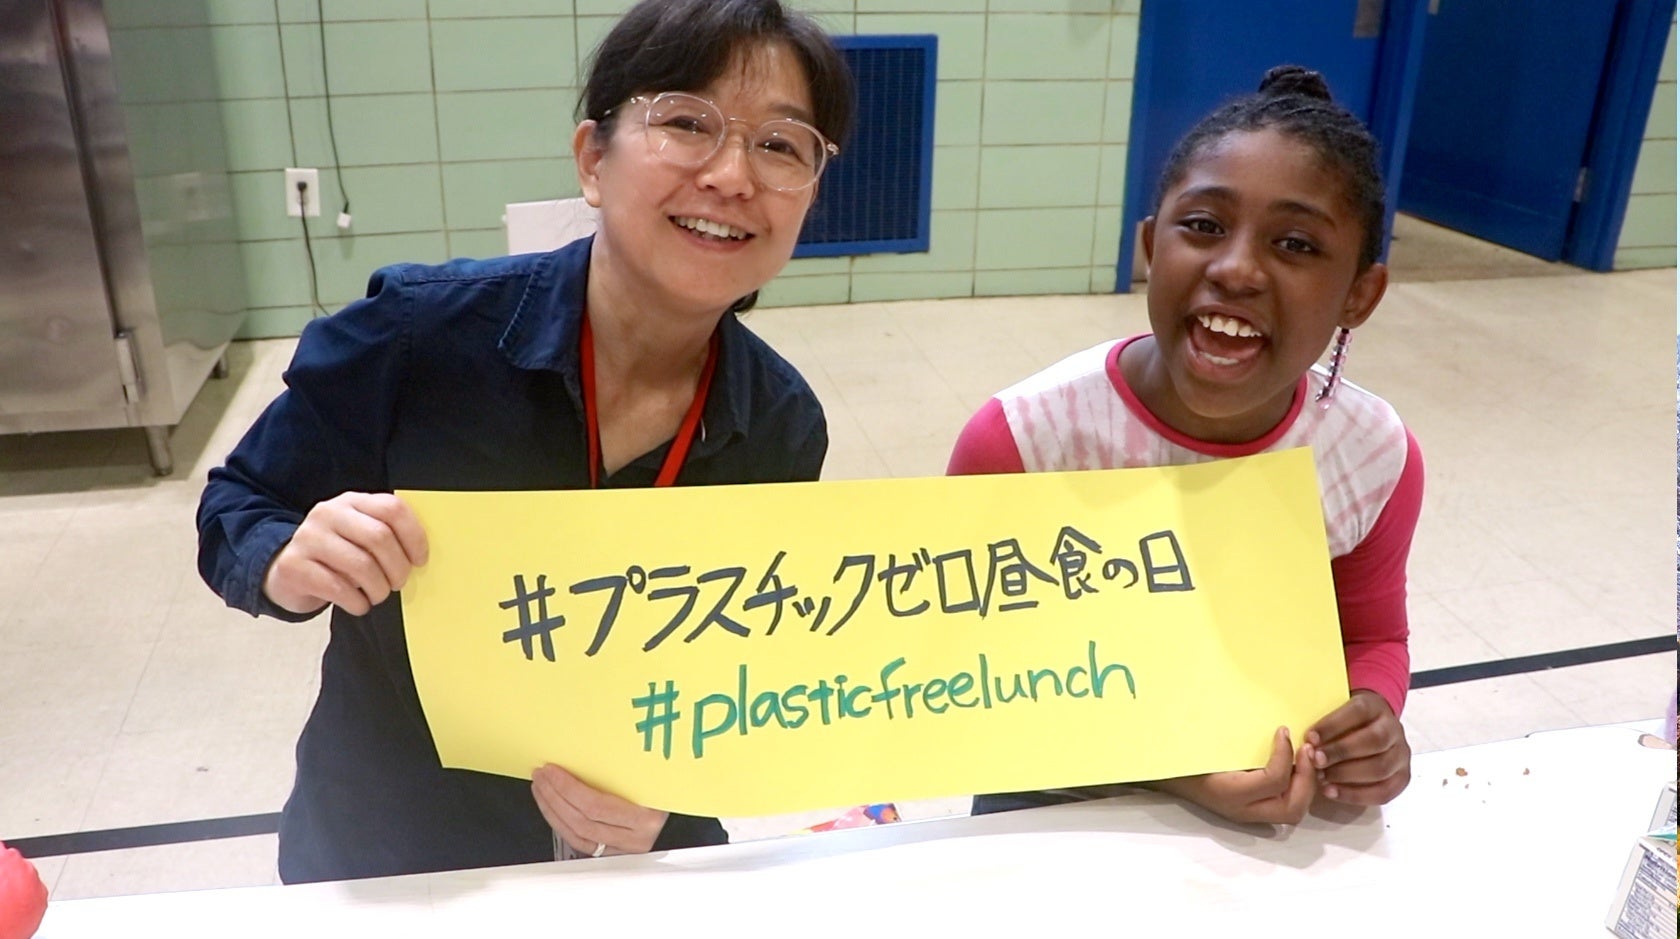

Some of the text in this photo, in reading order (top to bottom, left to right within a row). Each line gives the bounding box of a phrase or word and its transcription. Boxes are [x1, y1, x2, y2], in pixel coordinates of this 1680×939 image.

[498, 525, 1196, 662] #プラスチックゼロ昼食の日
[631, 640, 1136, 759] #plasticfreelunch
